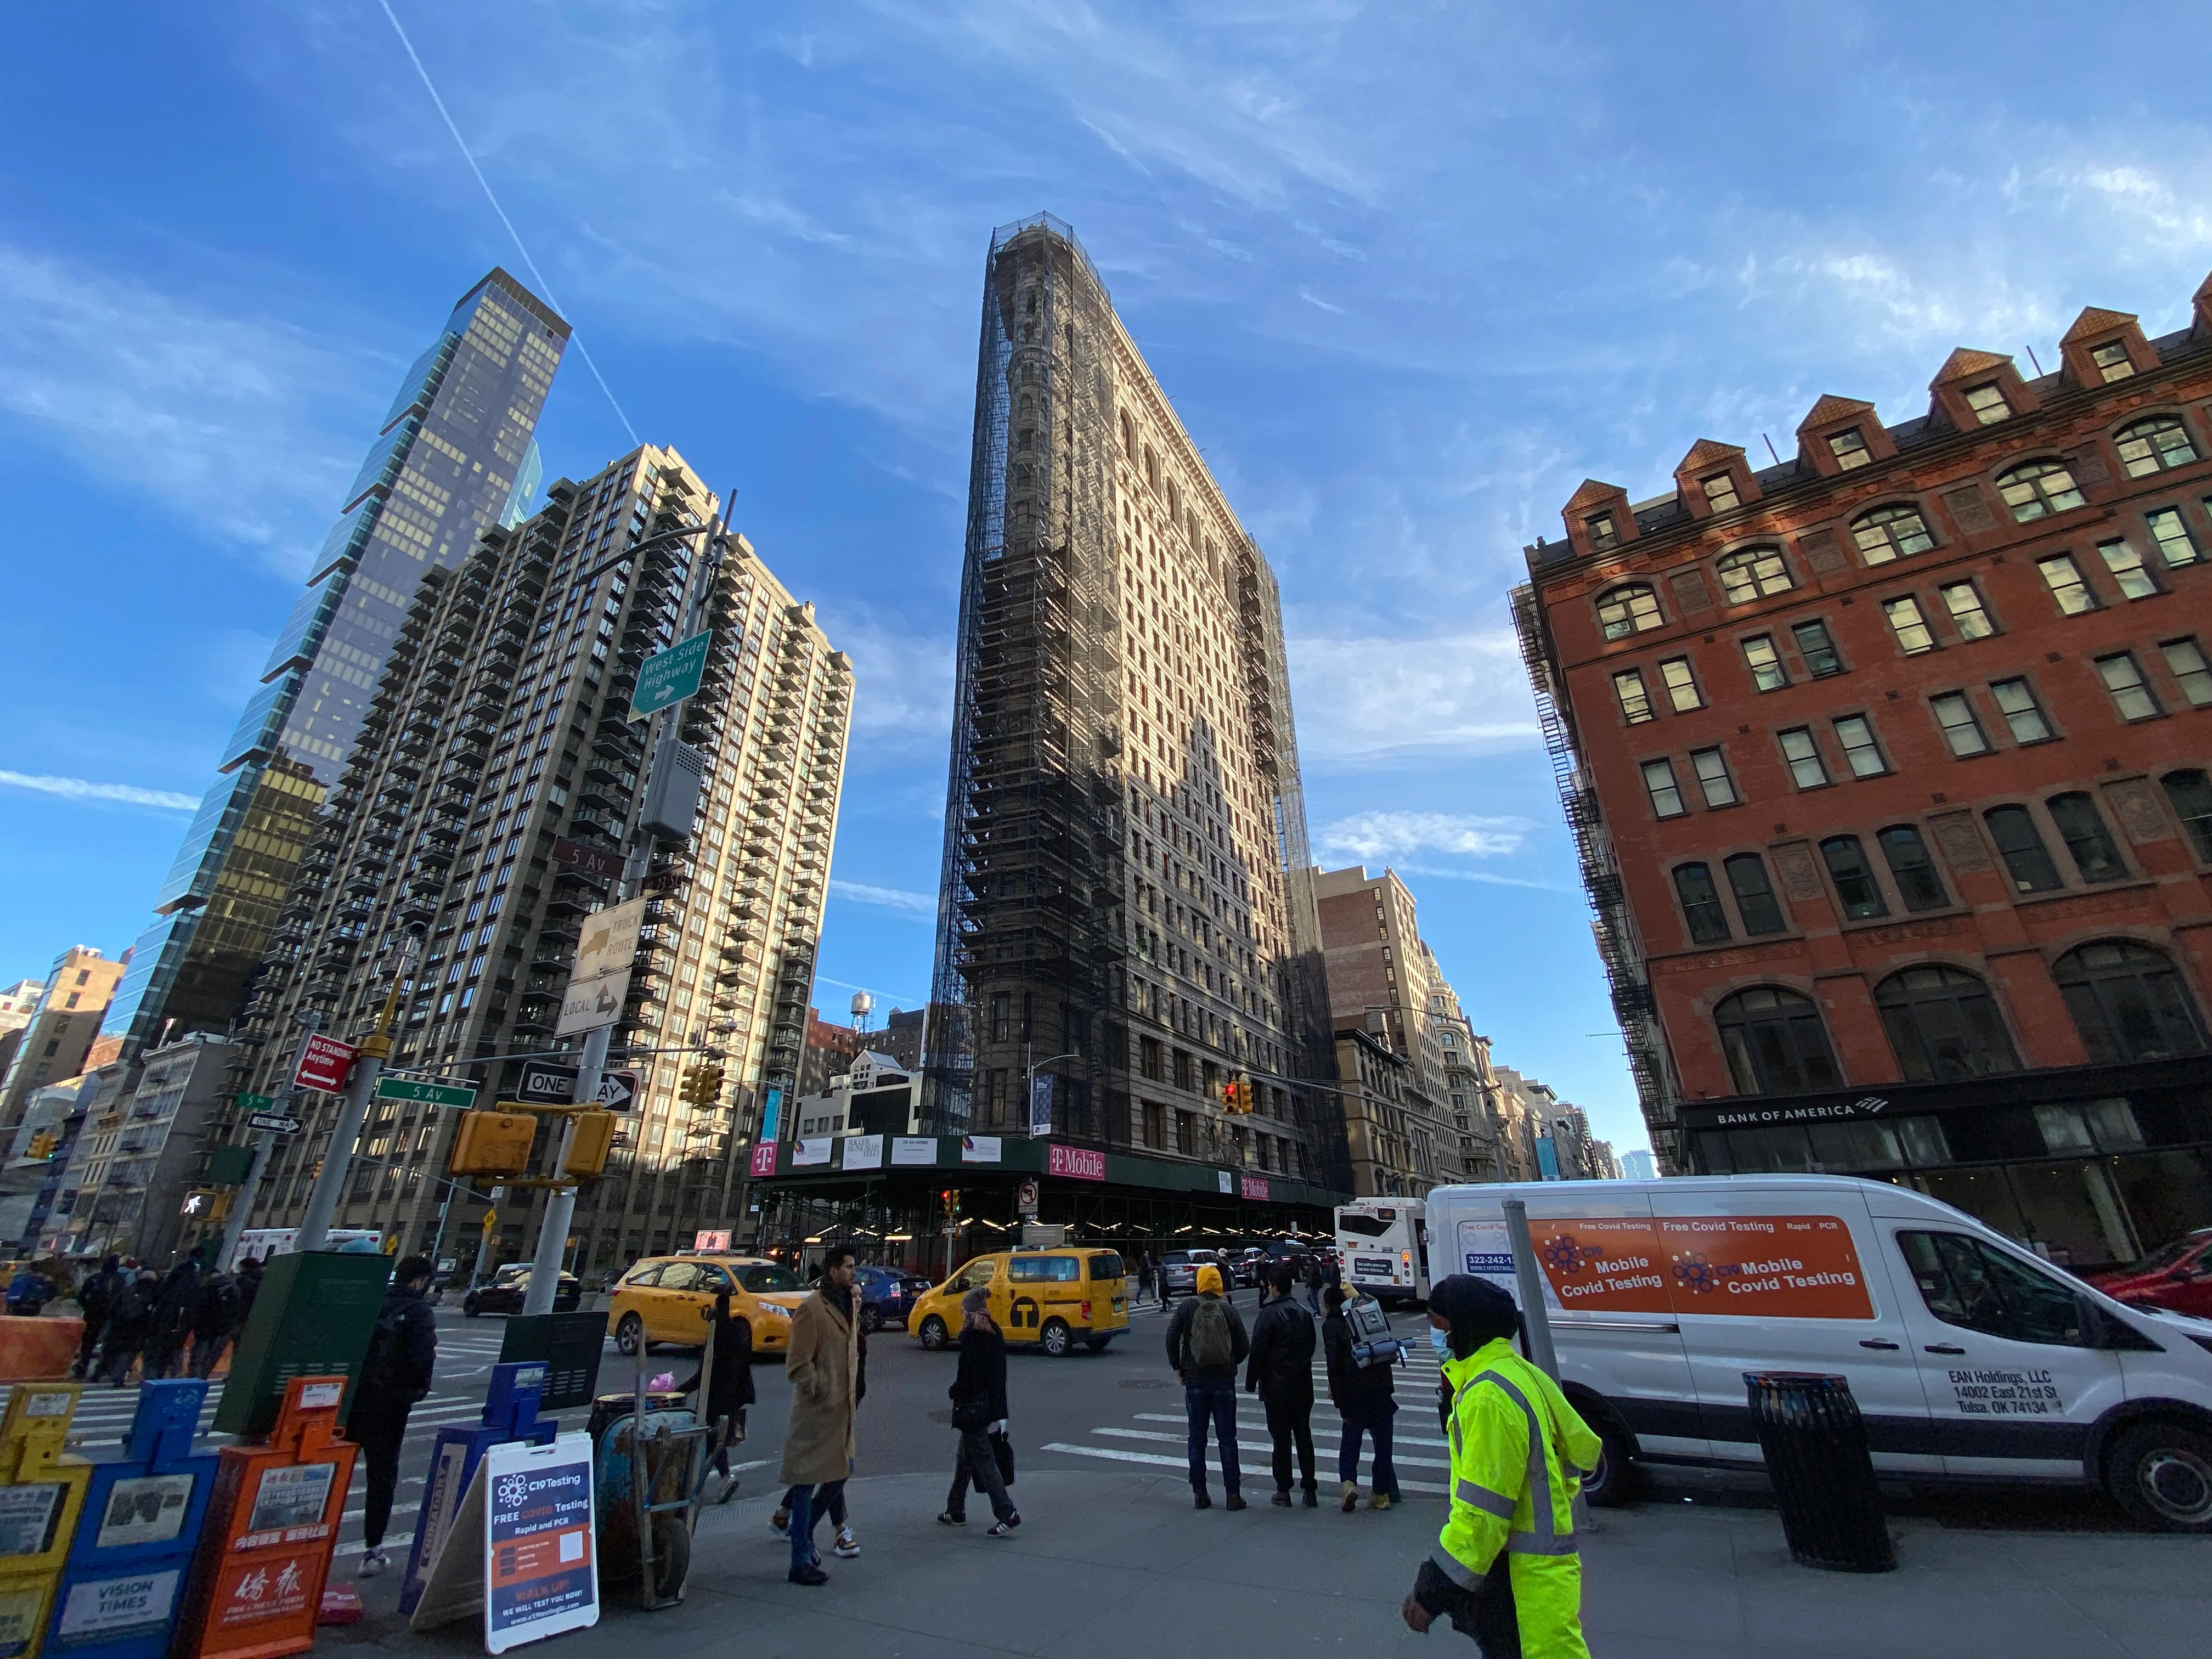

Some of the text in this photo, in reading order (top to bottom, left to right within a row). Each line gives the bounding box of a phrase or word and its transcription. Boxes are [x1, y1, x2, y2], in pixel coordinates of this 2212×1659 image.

[645, 641, 704, 675] West Side
[644, 658, 697, 690] Highway
[571, 849, 580, 865] 5
[613, 912, 640, 933] TRUCK
[606, 936, 635, 957] ROUTE
[564, 998, 590, 1017] LOCAL
[306, 1051, 335, 1066] Anytime
[309, 1039, 353, 1060] NO STANDING
[412, 1086, 422, 1097] 5
[532, 1075, 620, 1099] ONE AY
[246, 1096, 255, 1106] 5
[256, 1118, 296, 1129] ONE WAY
[1717, 1105, 1855, 1124] BANK OF AMERICA
[756, 1146, 774, 1172] T
[1065, 1150, 1103, 1177] Mobile
[1248, 1180, 1268, 1199] Mobile
[1622, 1222, 1651, 1231] Testing
[1663, 1221, 1775, 1233] Free Covid Testing
[1787, 1222, 1810, 1231] Rapid
[1595, 1256, 1649, 1274] Mobile
[1741, 1258, 1803, 1276] Mobile
[1561, 1274, 1662, 1297] Covid Testing
[1728, 1271, 1856, 1294] Covid Testing
[1017, 1305, 1033, 1328] T
[1948, 1370, 2052, 1386] EAN Holdings, LLC
[1953, 1385, 2058, 1398] 14002 East 21st St
[1956, 1400, 1991, 1414] Tulsa,
[1991, 1401, 2010, 1413] OK
[2010, 1401, 2048, 1414] 74134
[494, 1498, 588, 1525] FREE COVID Testing
[515, 1517, 569, 1535] Rapid and PCR
[99, 1580, 154, 1598] VISION
[515, 1579, 570, 1602] WALK UP!
[98, 1595, 147, 1613] TIMES
[503, 1589, 583, 1617] WE WILL TEST YOU NOW!
